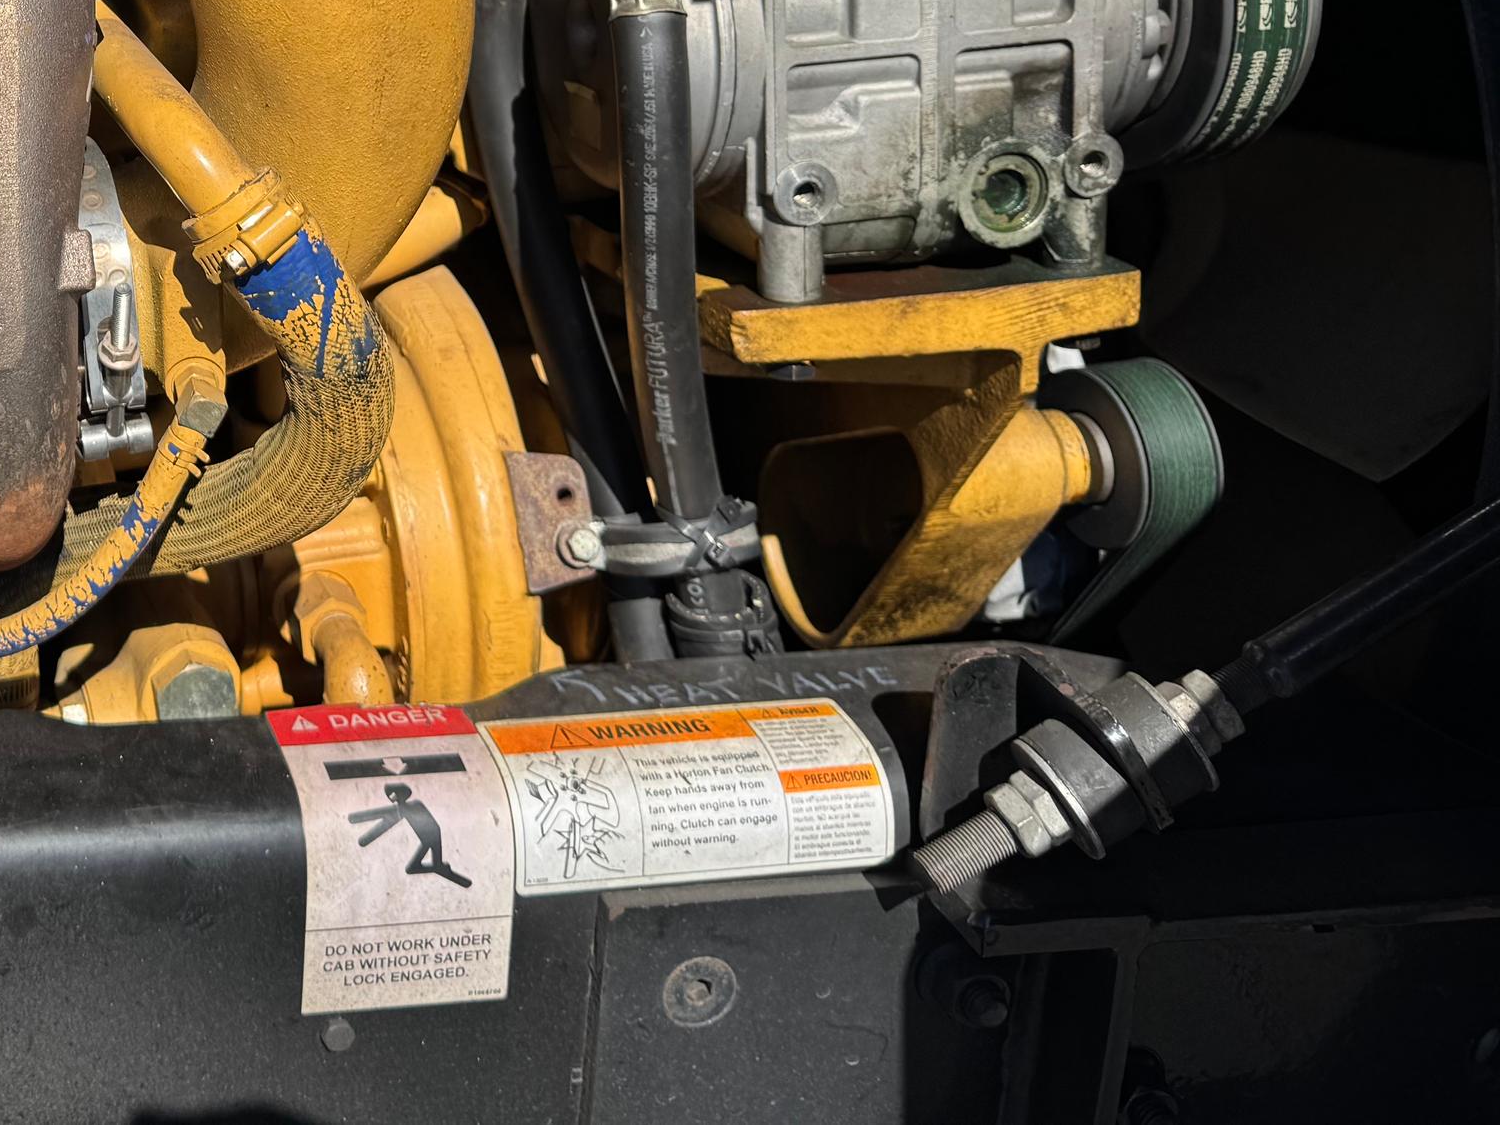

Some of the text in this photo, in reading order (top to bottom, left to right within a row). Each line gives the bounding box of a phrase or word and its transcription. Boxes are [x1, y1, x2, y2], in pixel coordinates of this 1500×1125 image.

[613, 666, 898, 705] HEAT VALVE
[327, 707, 448, 729] DANGER
[587, 718, 712, 742] WARNING
[633, 757, 657, 767] This
[661, 755, 697, 765] vehicle
[711, 750, 760, 762] equipped
[639, 771, 663, 781] with
[675, 767, 711, 779] Horton
[712, 766, 733, 776] Fan
[735, 763, 772, 774] Clutch.
[803, 770, 873, 786] PRECAUCION!
[645, 780, 765, 798] Keep hands away from
[648, 797, 772, 815] fan when engine is run-
[651, 814, 778, 832] ning. Clutch can engage
[652, 834, 739, 848] without warning.
[325, 933, 492, 957] DO NOT WORK UNDER
[323, 948, 492, 973] CAB WITHOUT SAFETY
[343, 966, 469, 987] LOCK ENGAGED.
